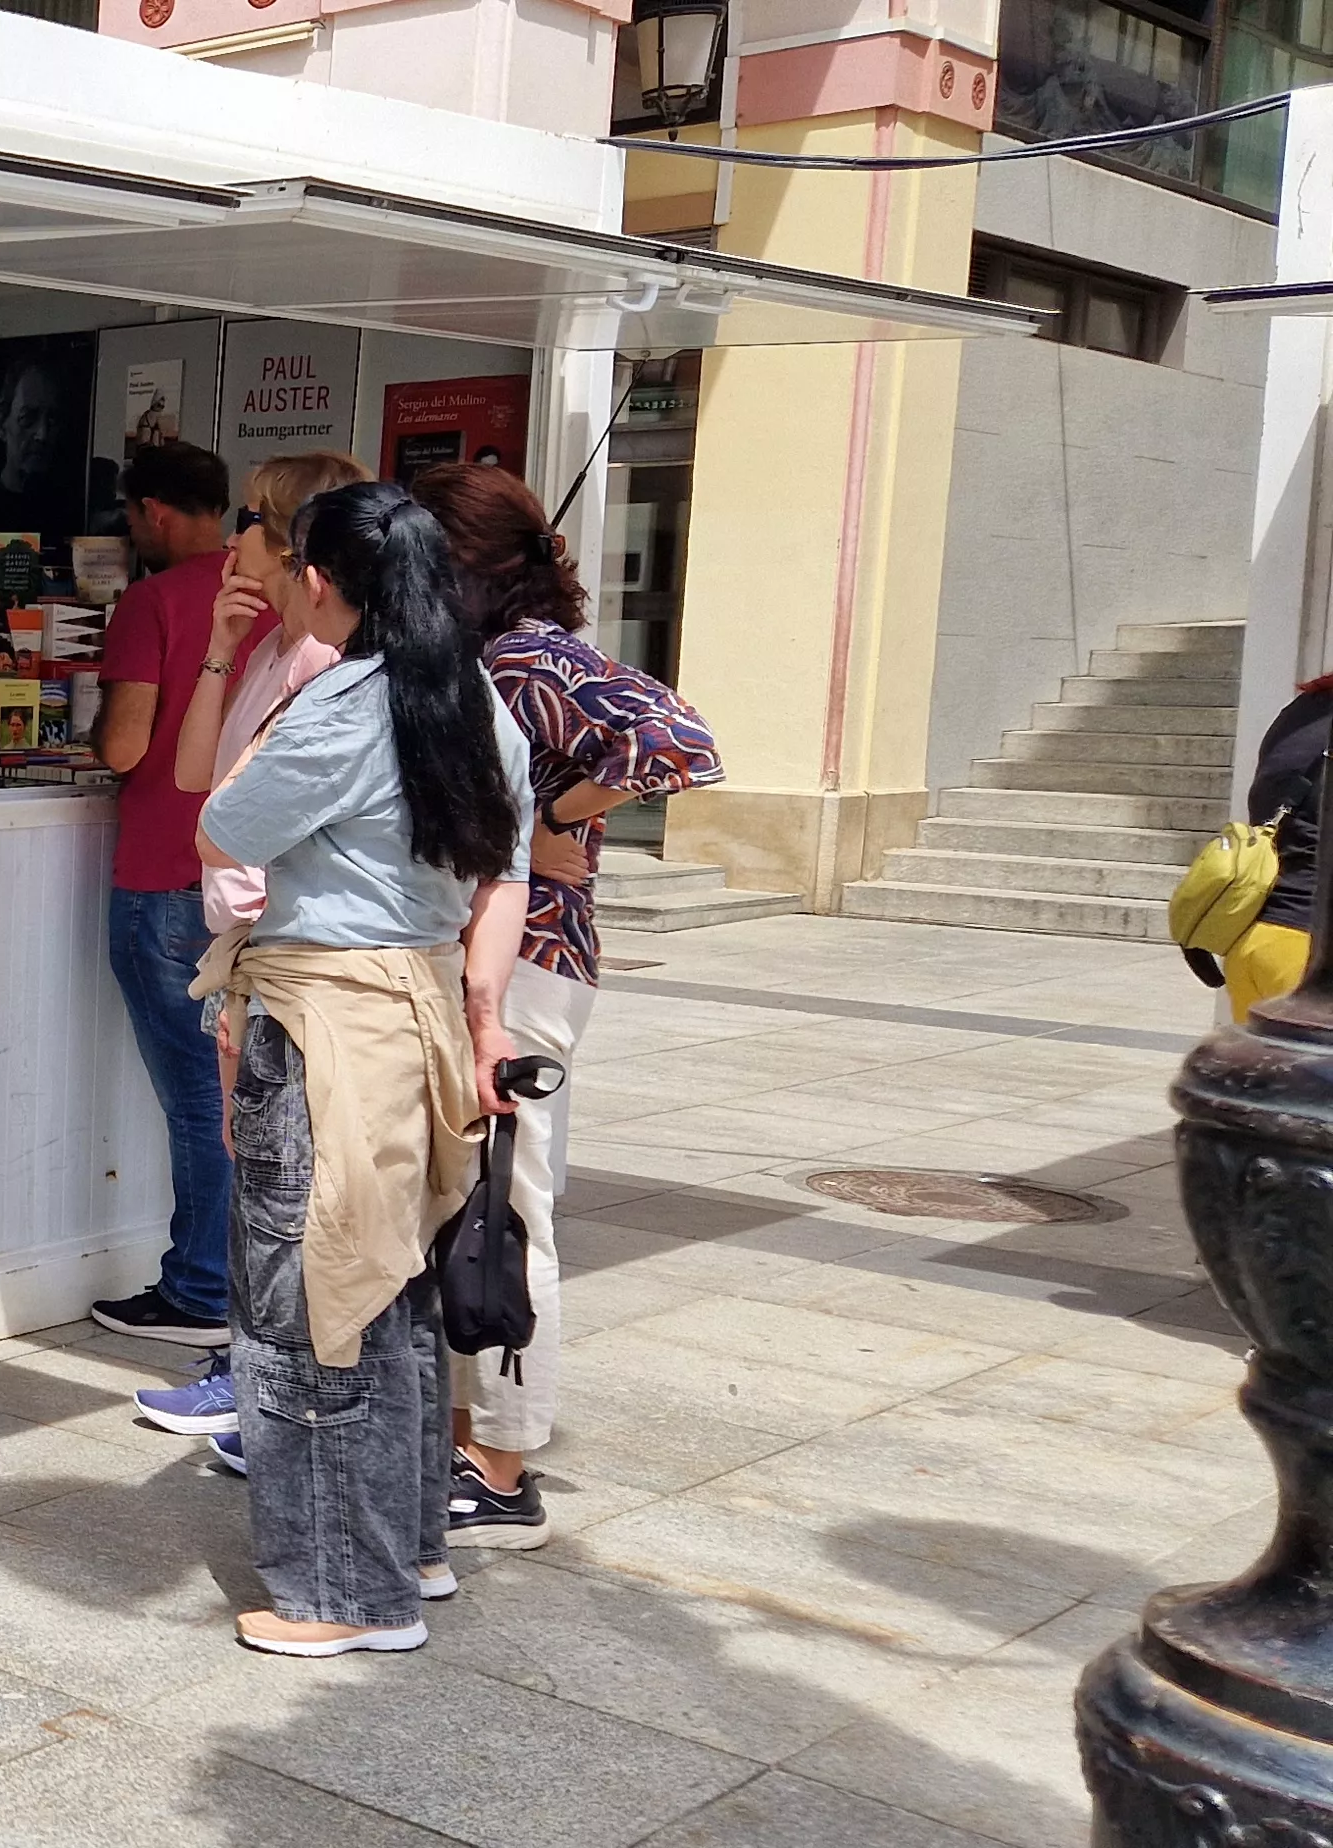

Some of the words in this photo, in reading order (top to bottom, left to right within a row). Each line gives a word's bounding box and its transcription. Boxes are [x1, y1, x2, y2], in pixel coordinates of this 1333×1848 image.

[262, 355, 317, 381] PAUL
[243, 386, 330, 413] AUSTER
[397, 397, 429, 412] Sergio
[431, 395, 446, 408] del
[449, 393, 487, 406] Molino
[397, 411, 413, 424] Los
[415, 410, 459, 423] alemanes
[238, 423, 333, 440] Baumgartner
